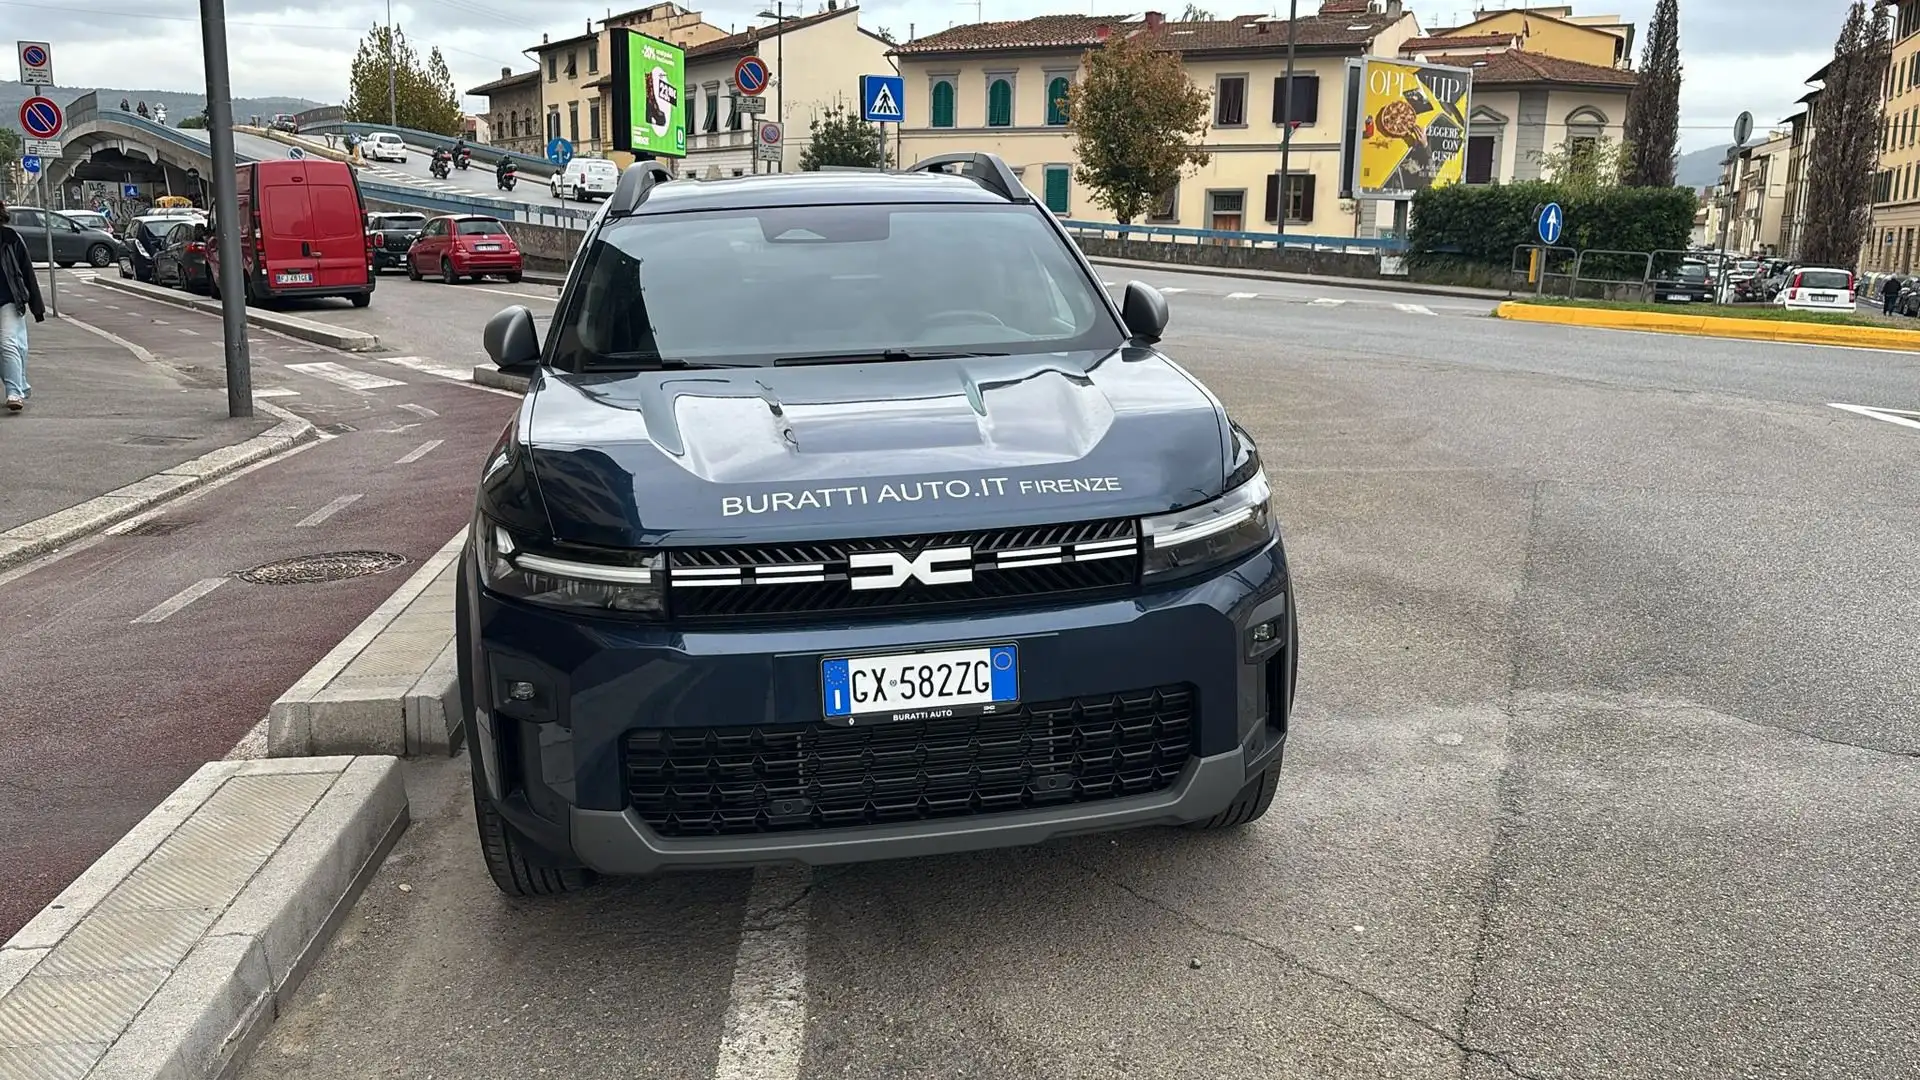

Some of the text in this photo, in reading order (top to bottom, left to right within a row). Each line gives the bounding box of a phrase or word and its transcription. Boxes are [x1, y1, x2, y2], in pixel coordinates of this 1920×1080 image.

[1433, 76, 1460, 103] UP
[1442, 139, 1458, 150] CON
[722, 476, 1123, 517] BURATTI AUTO.IT FIRENZE
[851, 660, 990, 703] GX 582ZG
[893, 709, 953, 721] BURATTI AUTO
